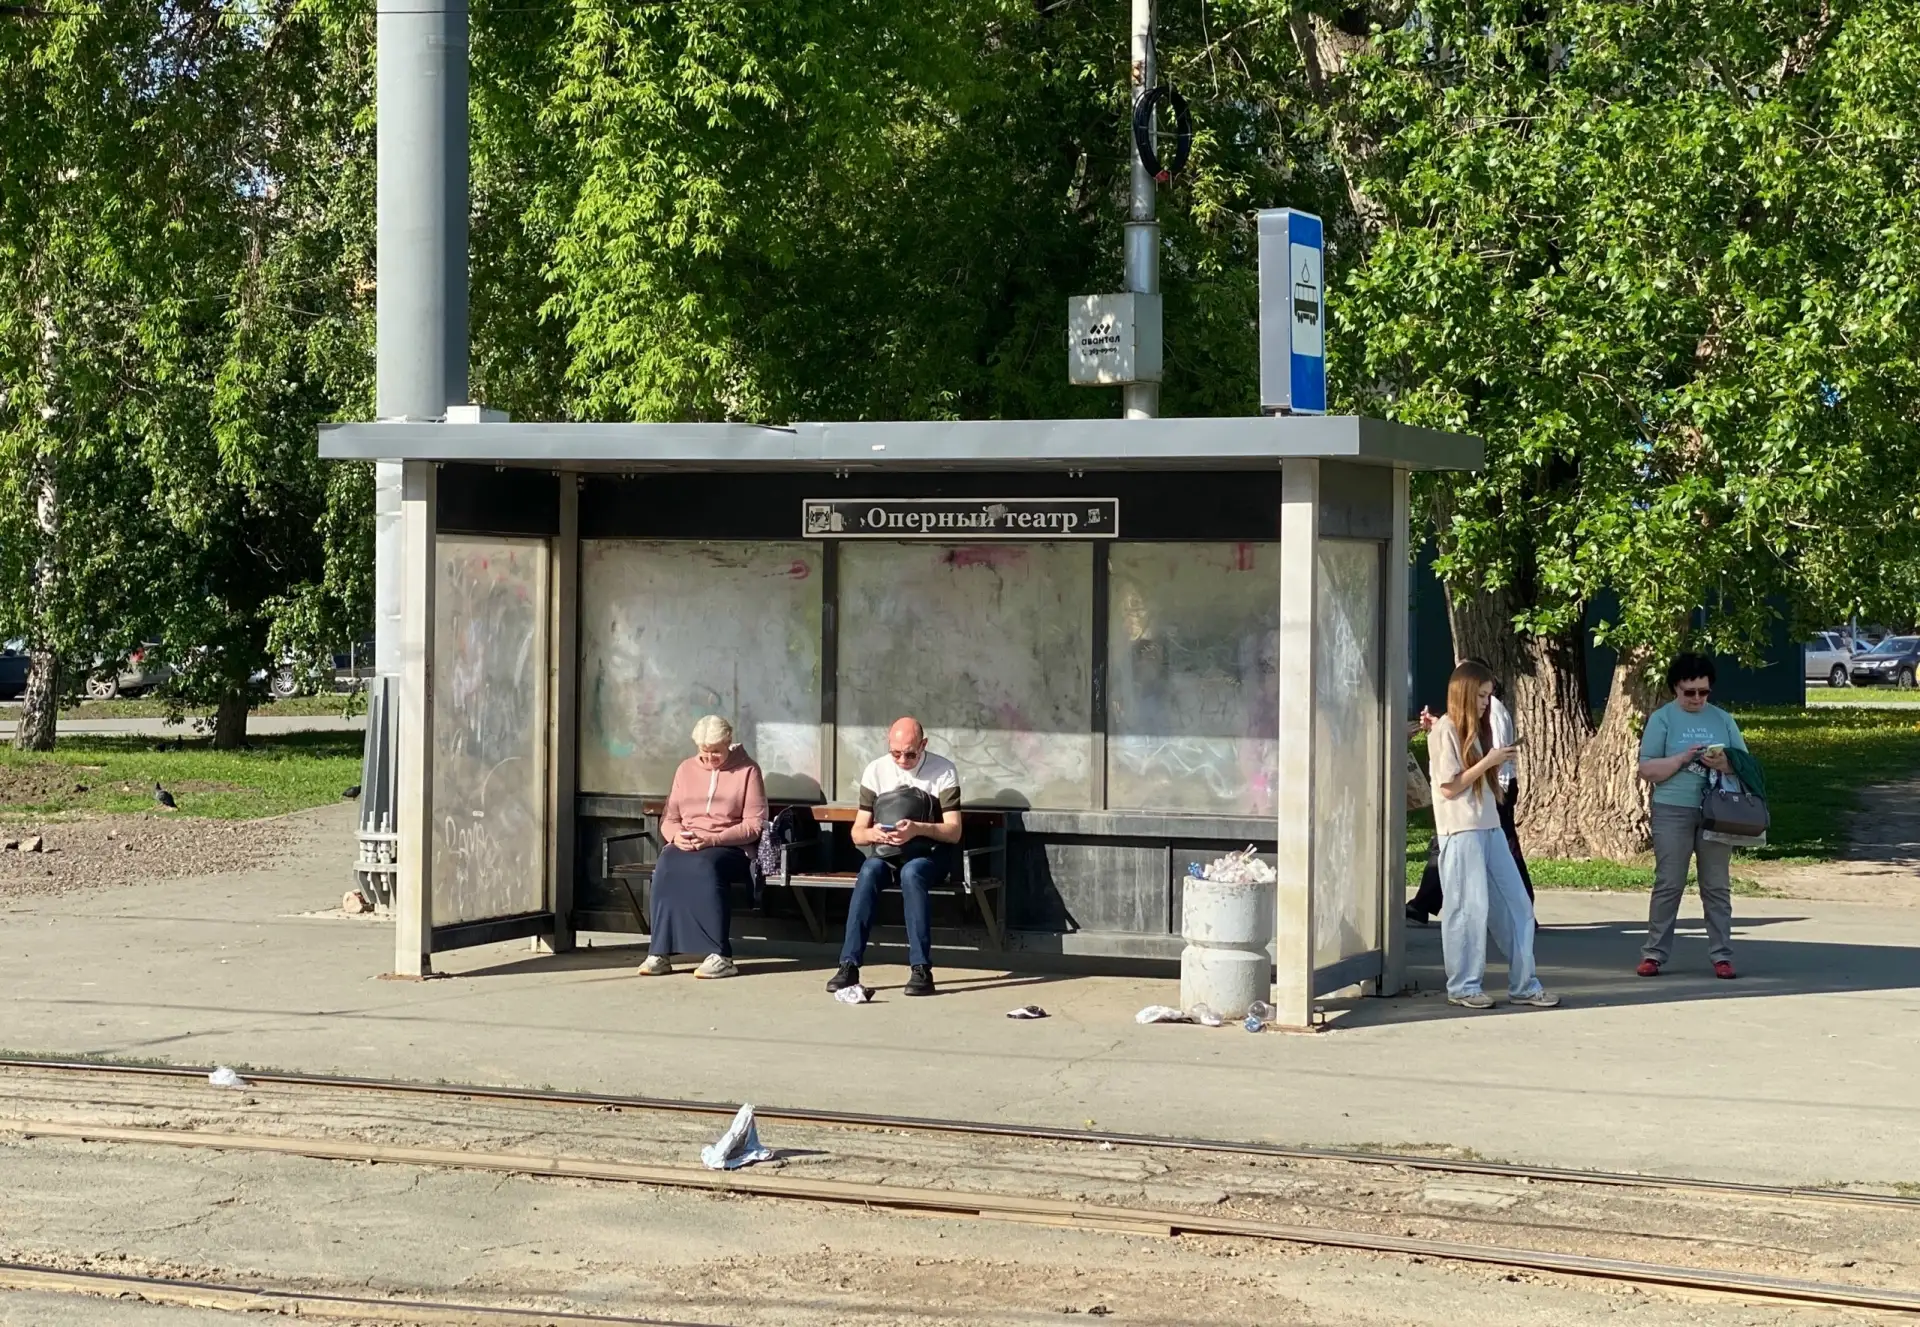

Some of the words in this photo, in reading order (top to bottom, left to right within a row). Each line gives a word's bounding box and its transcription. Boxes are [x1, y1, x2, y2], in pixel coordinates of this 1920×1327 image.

[1081, 335, 1120, 345] авантел
[867, 505, 996, 533] Оперный
[1003, 511, 1079, 533] театр
